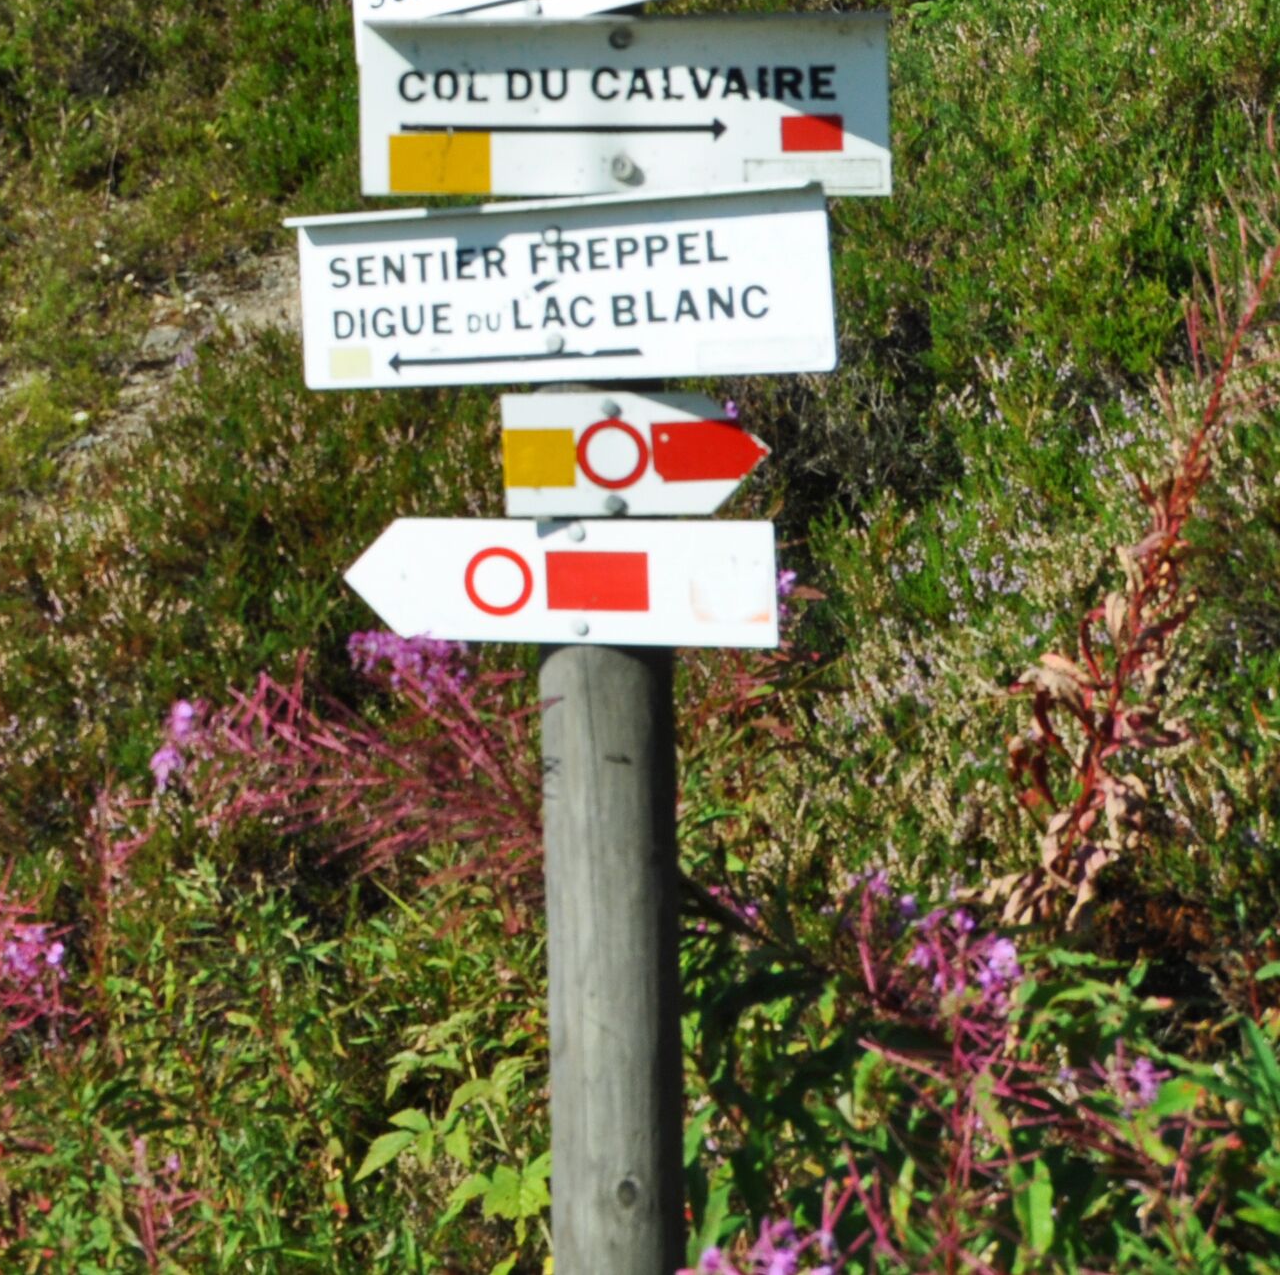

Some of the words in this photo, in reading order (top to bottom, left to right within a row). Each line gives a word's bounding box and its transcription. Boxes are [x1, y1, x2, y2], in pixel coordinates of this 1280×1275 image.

[398, 69, 488, 104] COL
[507, 68, 568, 102] DU
[591, 65, 836, 101] CALVAIRE
[329, 247, 507, 289] SENTIER
[529, 230, 729, 276] FREPPEL
[334, 304, 452, 340] DIGUE
[467, 313, 501, 333] DU
[512, 296, 595, 330] LAC
[611, 284, 769, 327] BLANC
